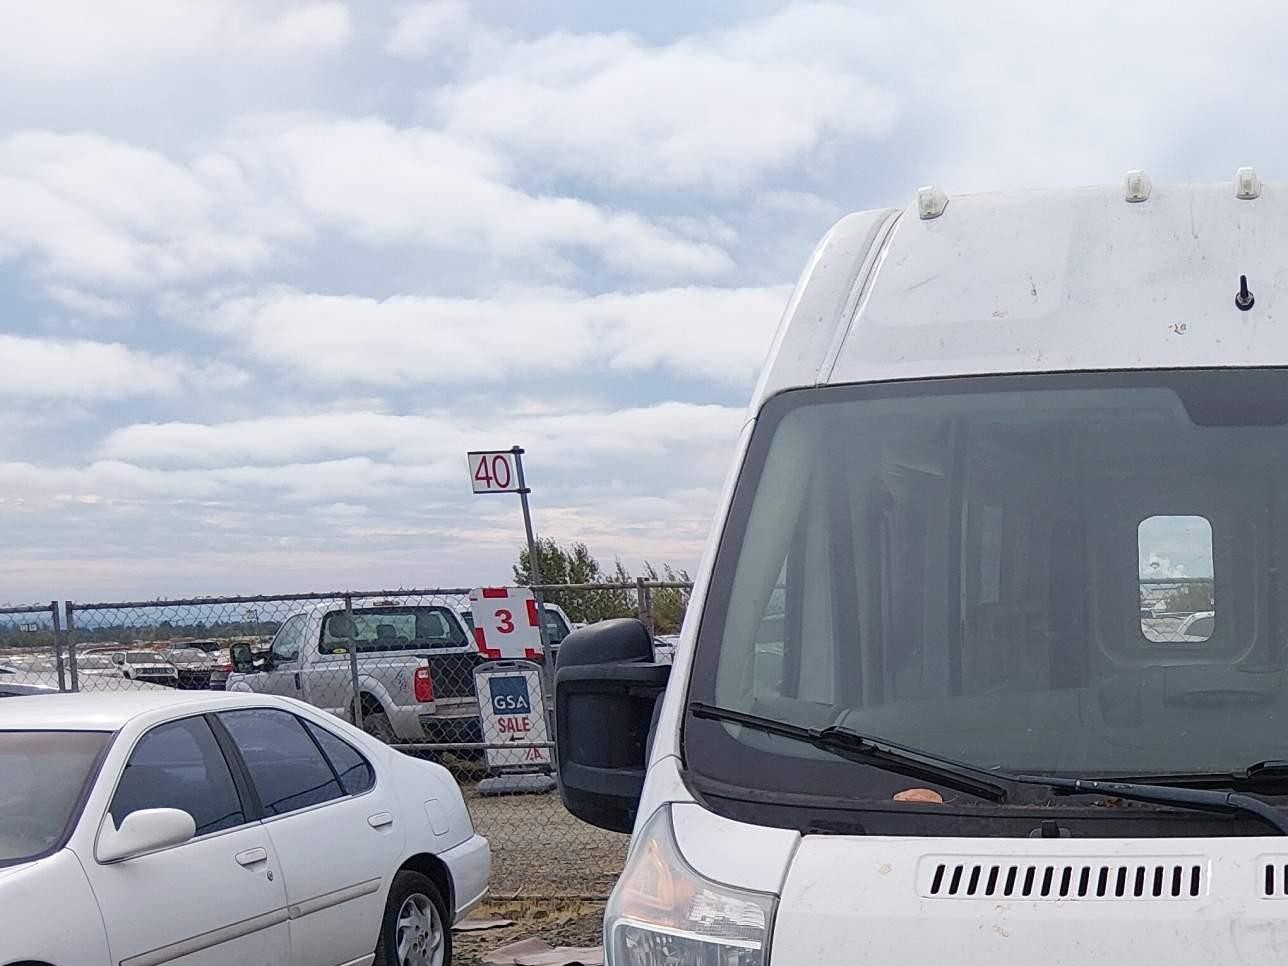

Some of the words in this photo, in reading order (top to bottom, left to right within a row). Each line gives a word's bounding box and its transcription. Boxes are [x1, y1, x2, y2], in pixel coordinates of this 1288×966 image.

[474, 454, 511, 489] 40
[495, 609, 515, 634] 3
[494, 695, 528, 710] GSA
[498, 716, 531, 733] SALE
